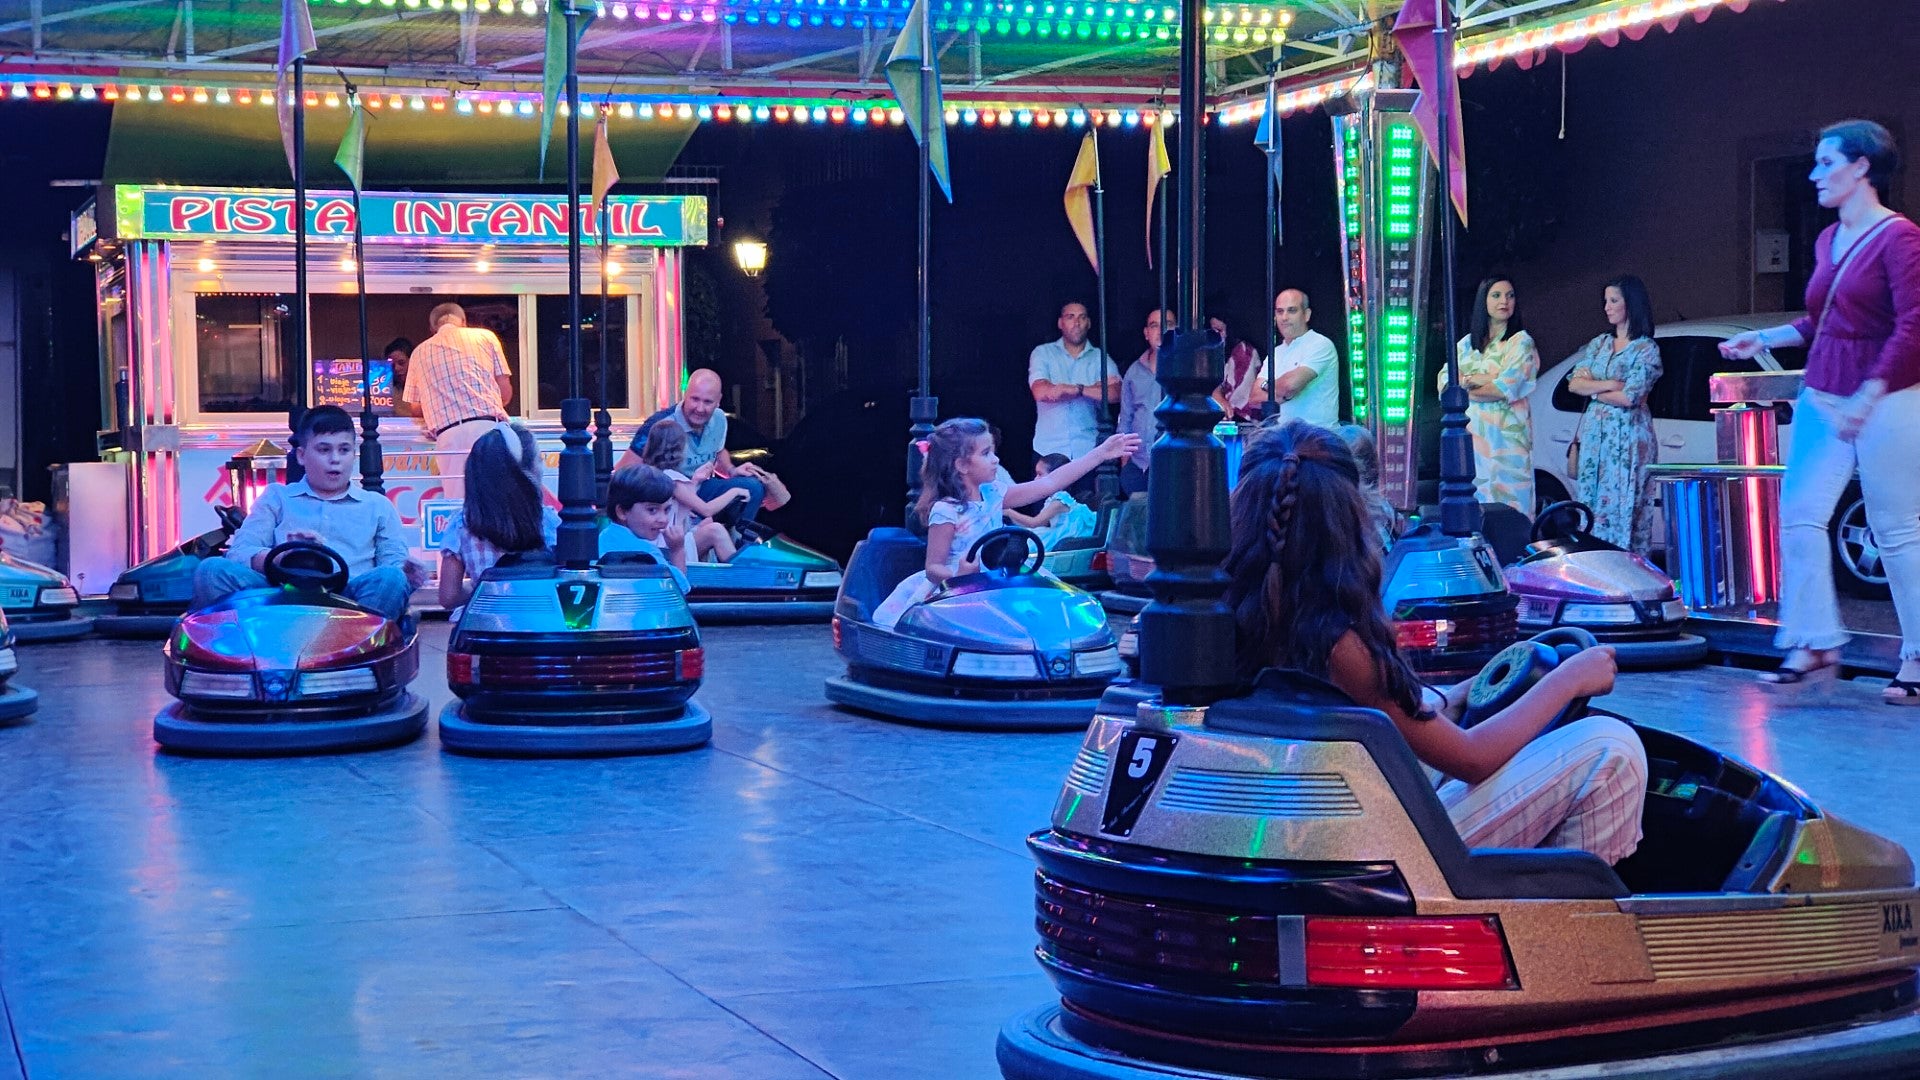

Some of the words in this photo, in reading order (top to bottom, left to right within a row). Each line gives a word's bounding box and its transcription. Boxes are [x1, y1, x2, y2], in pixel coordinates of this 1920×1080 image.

[170, 196, 356, 233] PISTA
[393, 201, 666, 236] INFANTIL
[570, 585, 586, 605] 7
[1127, 737, 1157, 778] 5
[1882, 903, 1913, 934] XIXA
